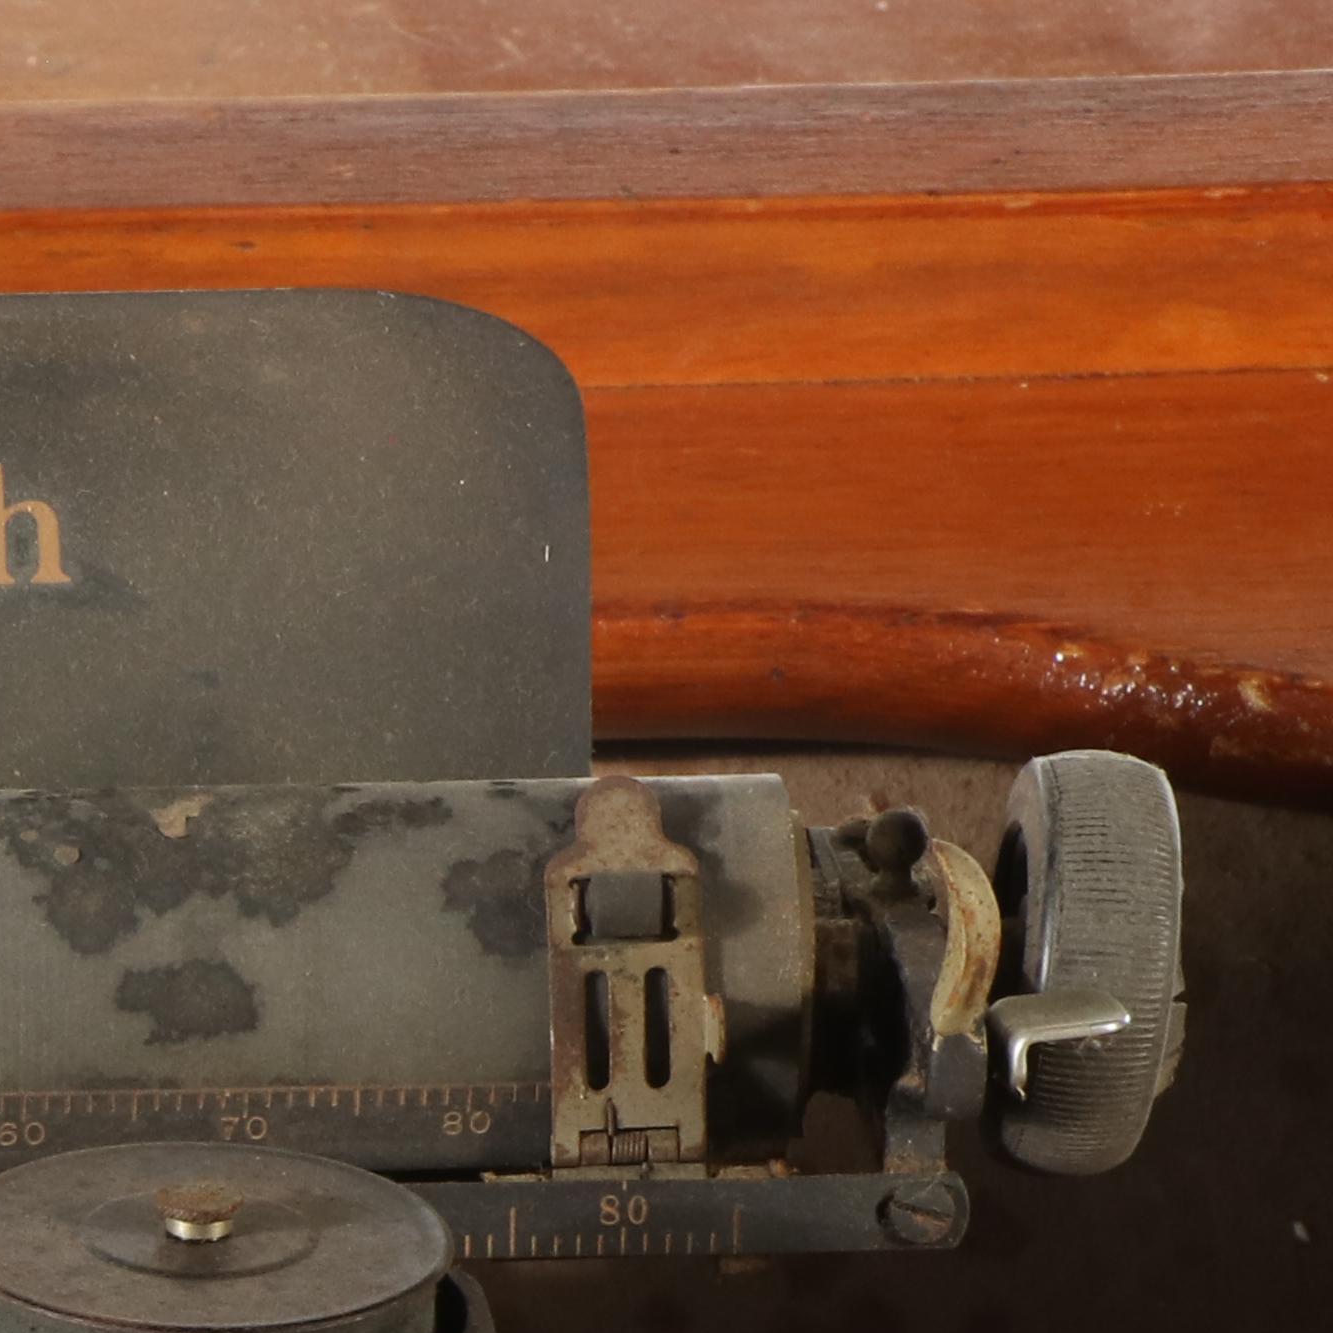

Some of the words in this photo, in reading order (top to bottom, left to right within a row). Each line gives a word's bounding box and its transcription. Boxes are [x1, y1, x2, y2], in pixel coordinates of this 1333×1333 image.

[220, 1117, 268, 1140] 70
[441, 1110, 491, 1135] 80
[599, 1196, 648, 1226] 80
